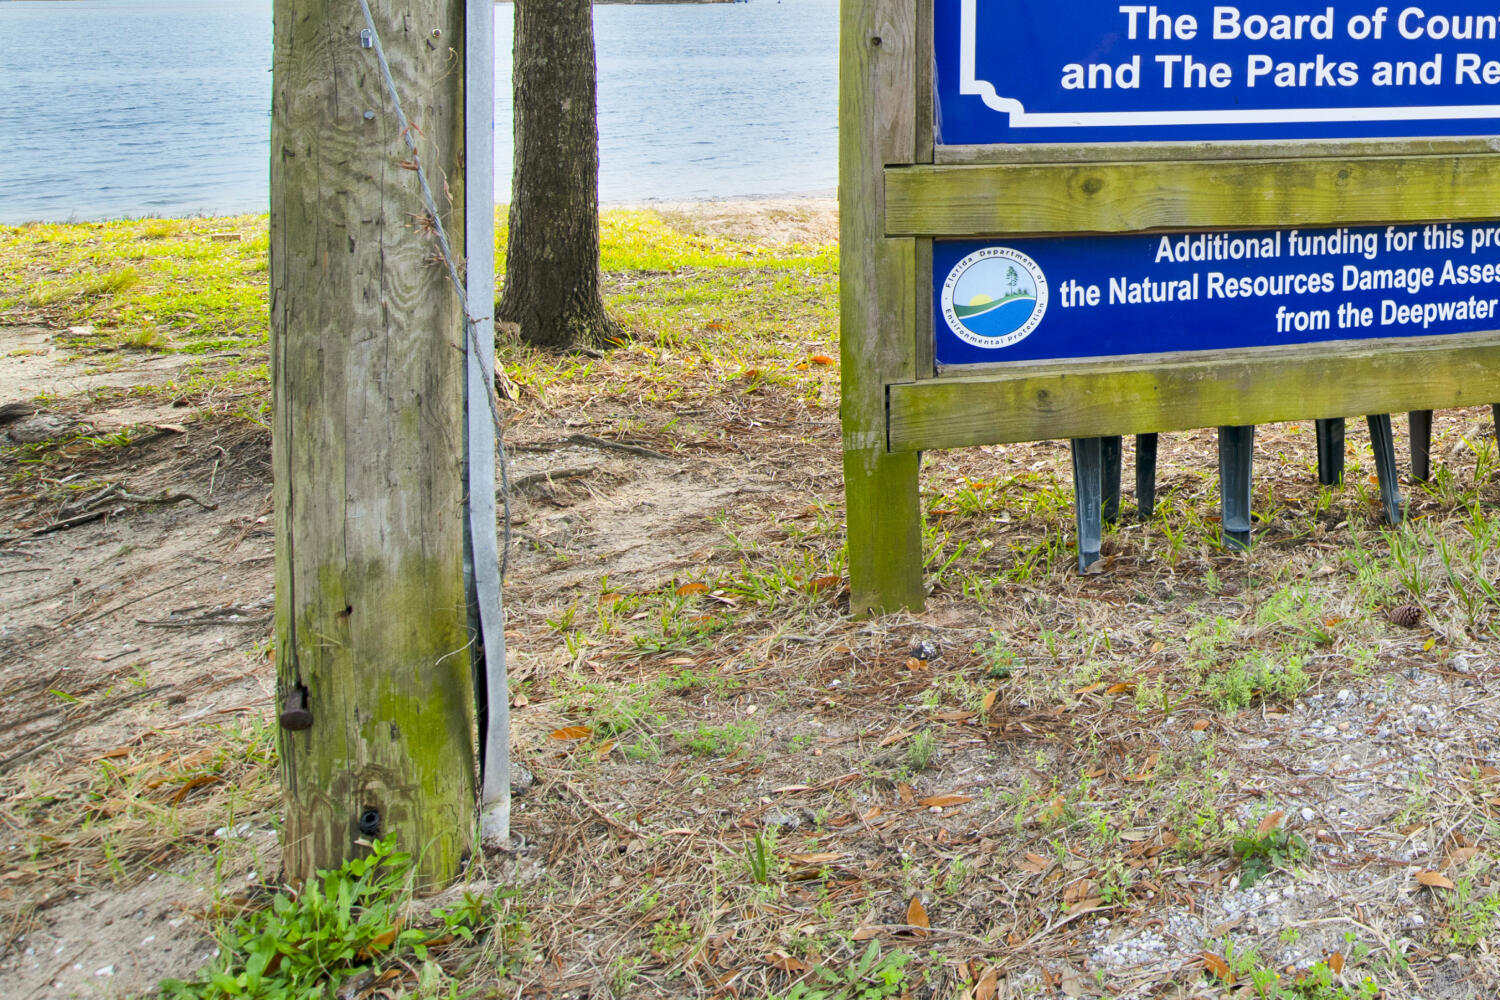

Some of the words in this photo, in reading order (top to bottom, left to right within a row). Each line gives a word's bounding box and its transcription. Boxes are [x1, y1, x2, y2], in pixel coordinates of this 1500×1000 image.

[1120, 6, 1198, 40] The
[1213, 7, 1334, 40] Board
[1348, 7, 1388, 40] of
[1061, 56, 1141, 89] and
[1155, 55, 1232, 88] The
[1248, 55, 1359, 87] Parks
[1372, 54, 1443, 86] and
[1155, 231, 1281, 263] Additional
[1289, 228, 1378, 260] funding
[1385, 227, 1418, 252] for
[1424, 225, 1464, 250] this
[946, 257, 973, 288] Florida
[979, 249, 1036, 271] Department
[1037, 274, 1046, 284] of
[1060, 280, 1101, 307] the
[1110, 274, 1199, 305] Natural
[1208, 271, 1335, 299] Resources
[1343, 265, 1434, 294] Damage
[945, 308, 1004, 345] Environmental
[1007, 303, 1044, 341] Protection
[1276, 306, 1330, 333] from
[1338, 303, 1374, 329] the
[1381, 296, 1499, 329] Deepwater
